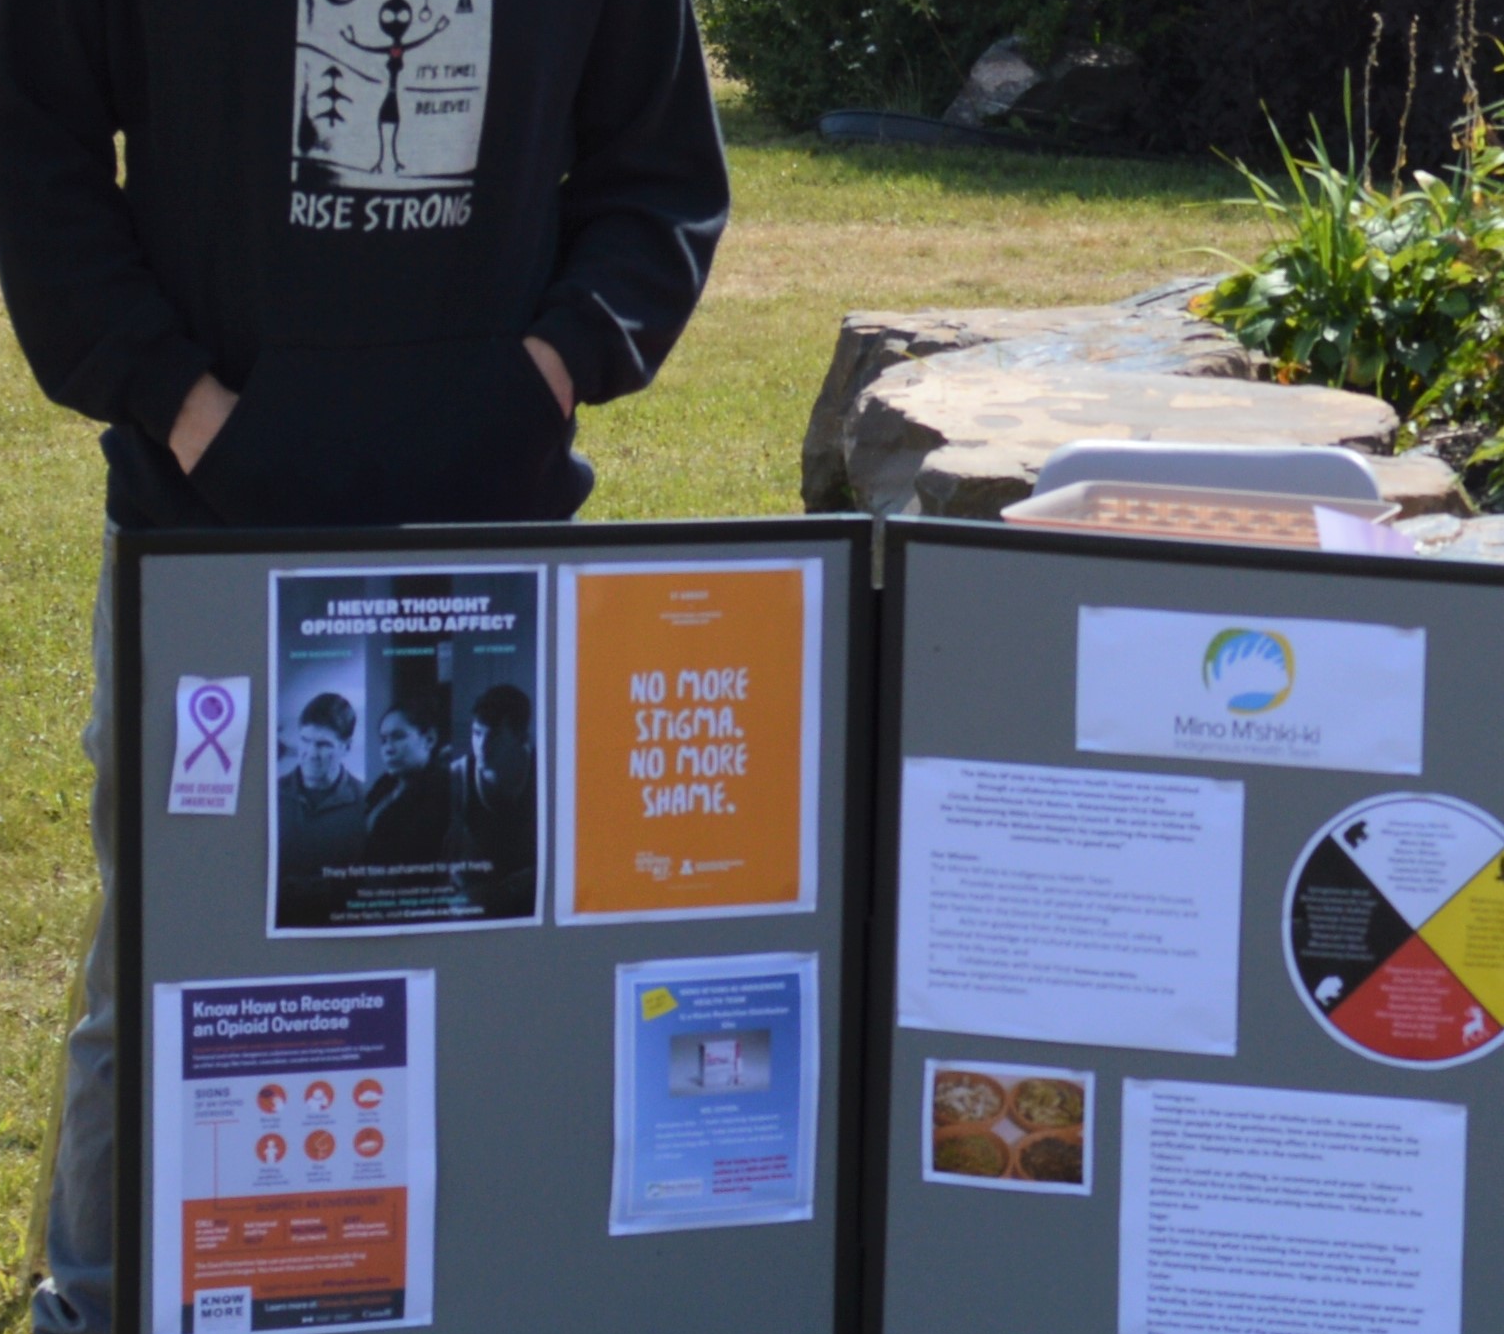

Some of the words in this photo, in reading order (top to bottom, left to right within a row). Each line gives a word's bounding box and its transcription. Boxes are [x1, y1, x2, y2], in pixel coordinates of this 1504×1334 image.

[290, 191, 354, 230] RISE
[363, 192, 472, 232] STRONG
[327, 601, 334, 616] I
[338, 599, 400, 616] NEVER
[401, 596, 490, 615] THOUGHT
[300, 619, 377, 635] OPIOIDS
[380, 617, 445, 634] COULD
[445, 614, 516, 632] AFFECT
[630, 671, 666, 703] NO
[677, 667, 749, 701] MORE
[1174, 715, 1227, 738] Mino
[629, 746, 665, 779] NO
[676, 742, 749, 777] MORE
[642, 781, 736, 818] SHAME.
[193, 1001, 238, 1018] Know
[241, 998, 277, 1015] How
[280, 999, 297, 1013] to
[300, 993, 384, 1014] Recognize
[193, 1022, 214, 1037] an
[216, 1017, 268, 1038] Opioid
[271, 1014, 349, 1034] Overdose
[195, 1087, 231, 1099] SIGNS
[200, 1294, 245, 1307] KNOW
[200, 1306, 244, 1319] MORE
